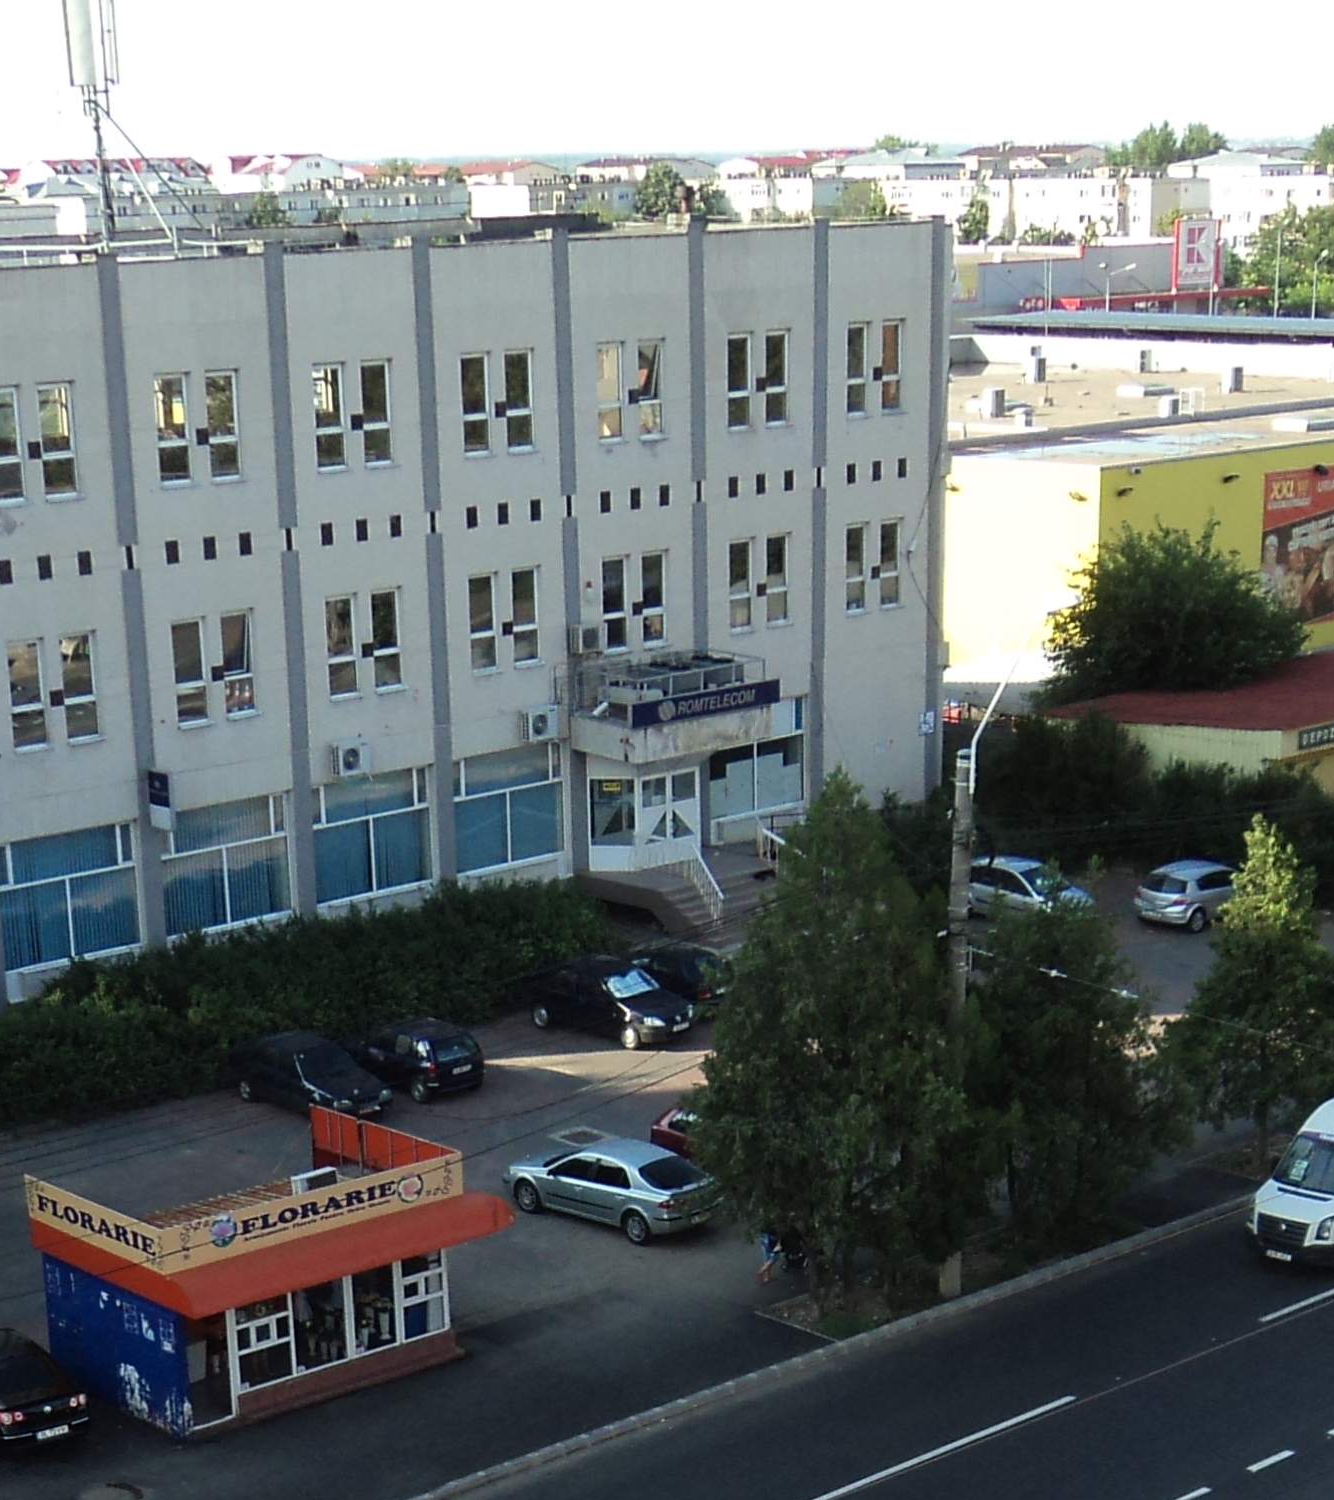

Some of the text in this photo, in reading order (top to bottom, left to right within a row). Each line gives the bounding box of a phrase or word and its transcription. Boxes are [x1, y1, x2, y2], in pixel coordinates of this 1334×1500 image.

[677, 689, 756, 715] ROMTELECOM
[36, 1194, 157, 1257] FLORARIE
[240, 1180, 397, 1236] FLORARIE
